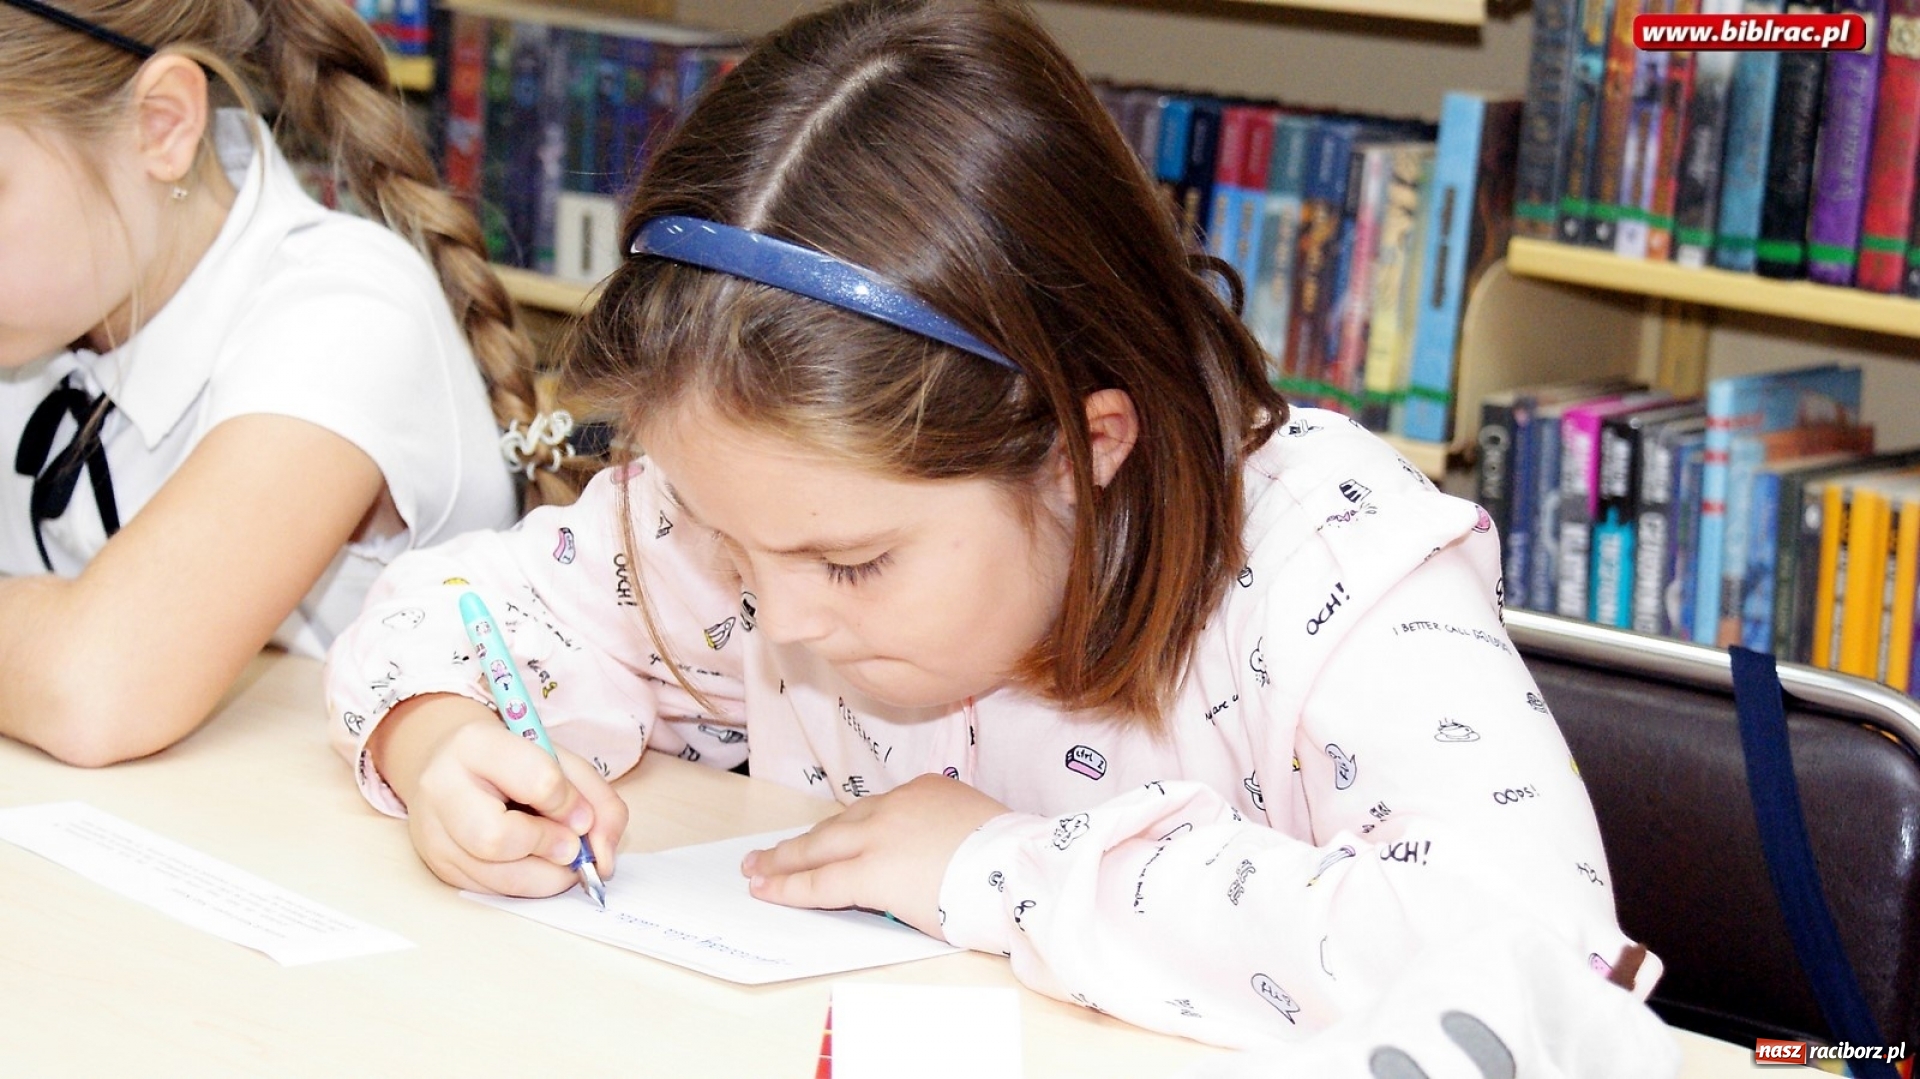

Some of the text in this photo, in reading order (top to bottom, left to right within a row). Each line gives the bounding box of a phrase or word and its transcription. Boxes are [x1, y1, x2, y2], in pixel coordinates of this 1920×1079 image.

[613, 552, 638, 606] OUCH!
[1401, 621, 1441, 633] BETTER
[1444, 624, 1470, 636] CALL
